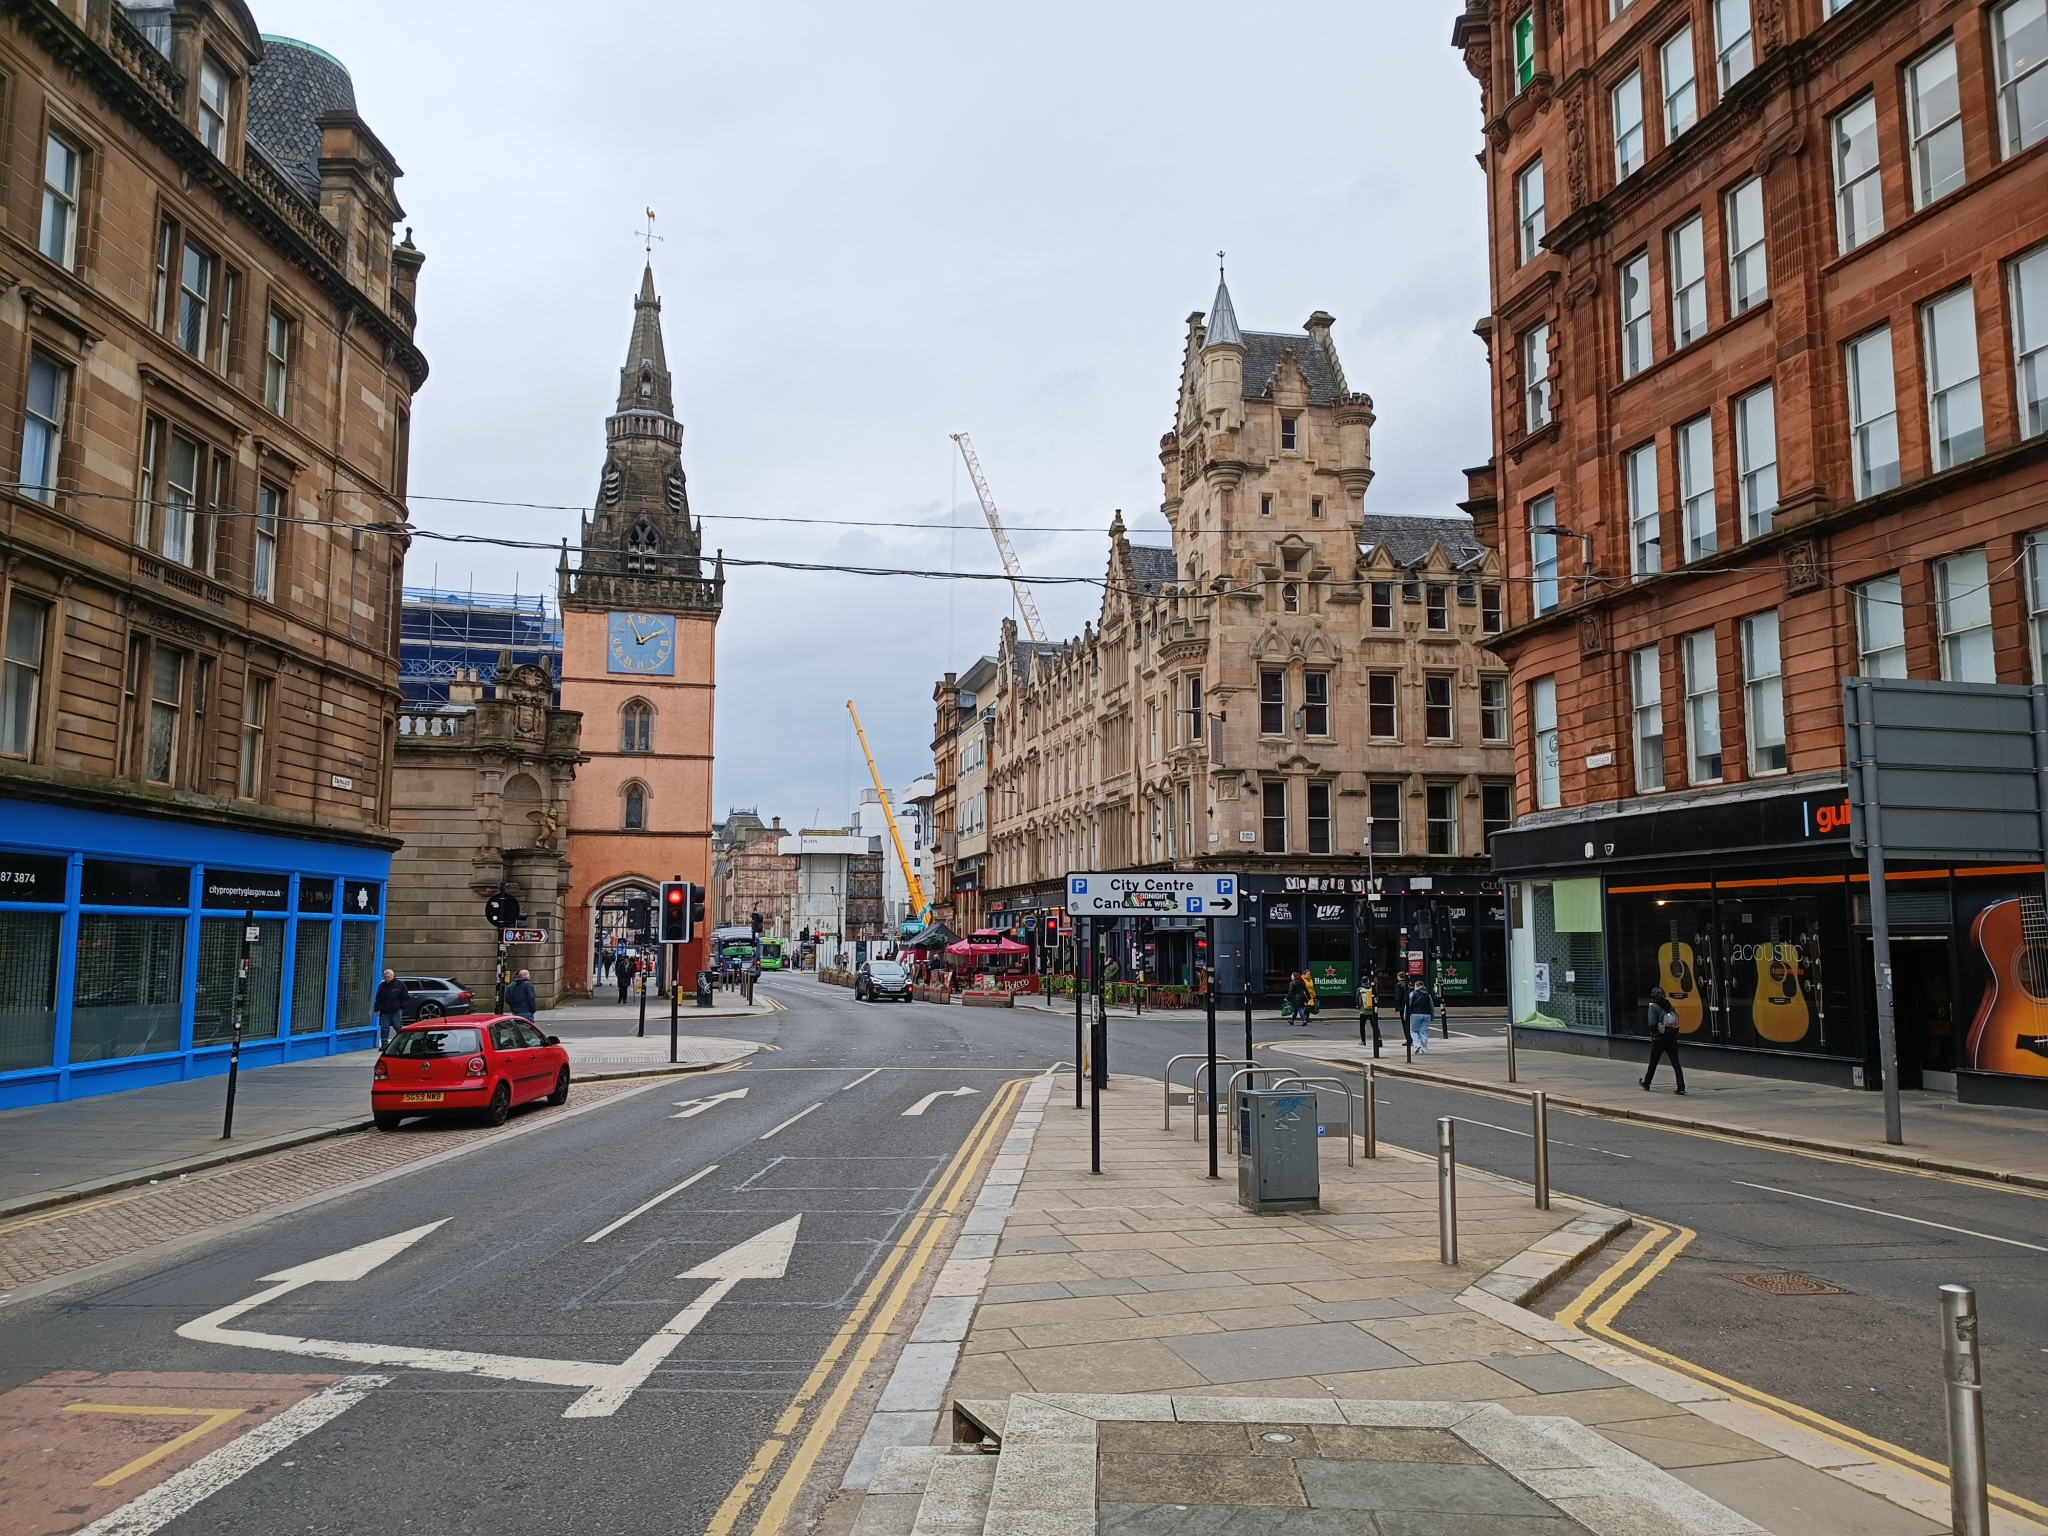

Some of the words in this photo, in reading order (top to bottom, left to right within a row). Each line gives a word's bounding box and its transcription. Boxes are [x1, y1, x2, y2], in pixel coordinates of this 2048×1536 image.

[13, 872, 36, 884] 3874
[209, 885, 281, 898] citypropertyglasgow.co.uk
[1110, 879, 1139, 892] City
[1144, 879, 1194, 891] Centre
[1732, 940, 1804, 962] acoustic
[1314, 977, 1347, 985] Heineken
